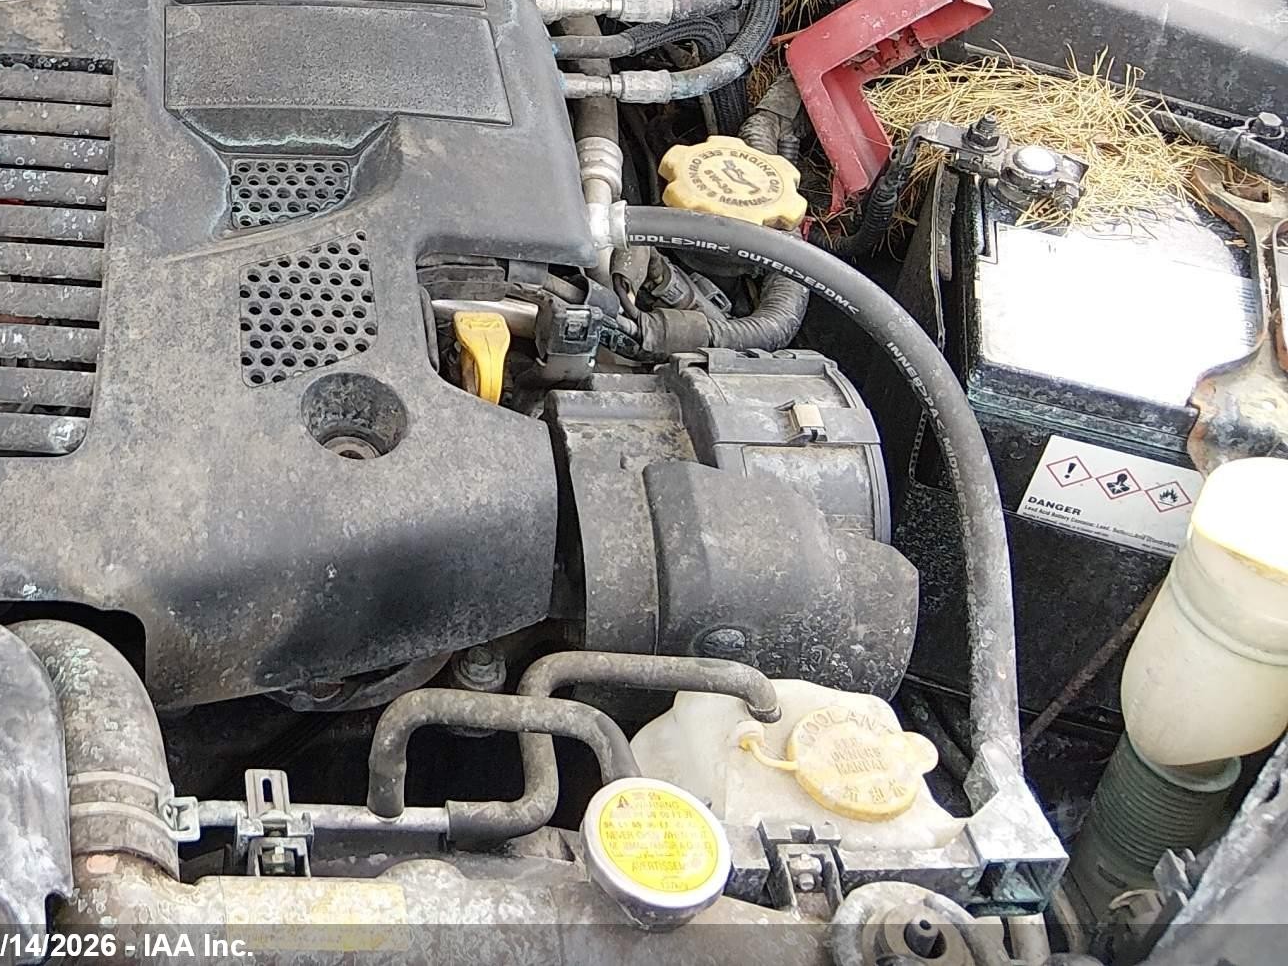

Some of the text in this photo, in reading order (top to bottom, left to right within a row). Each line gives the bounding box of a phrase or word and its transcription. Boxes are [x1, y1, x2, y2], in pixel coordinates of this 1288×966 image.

[730, 150, 781, 194] ENGINE OIL
[719, 194, 773, 207] MANUAL
[1027, 496, 1082, 516] DANGER
